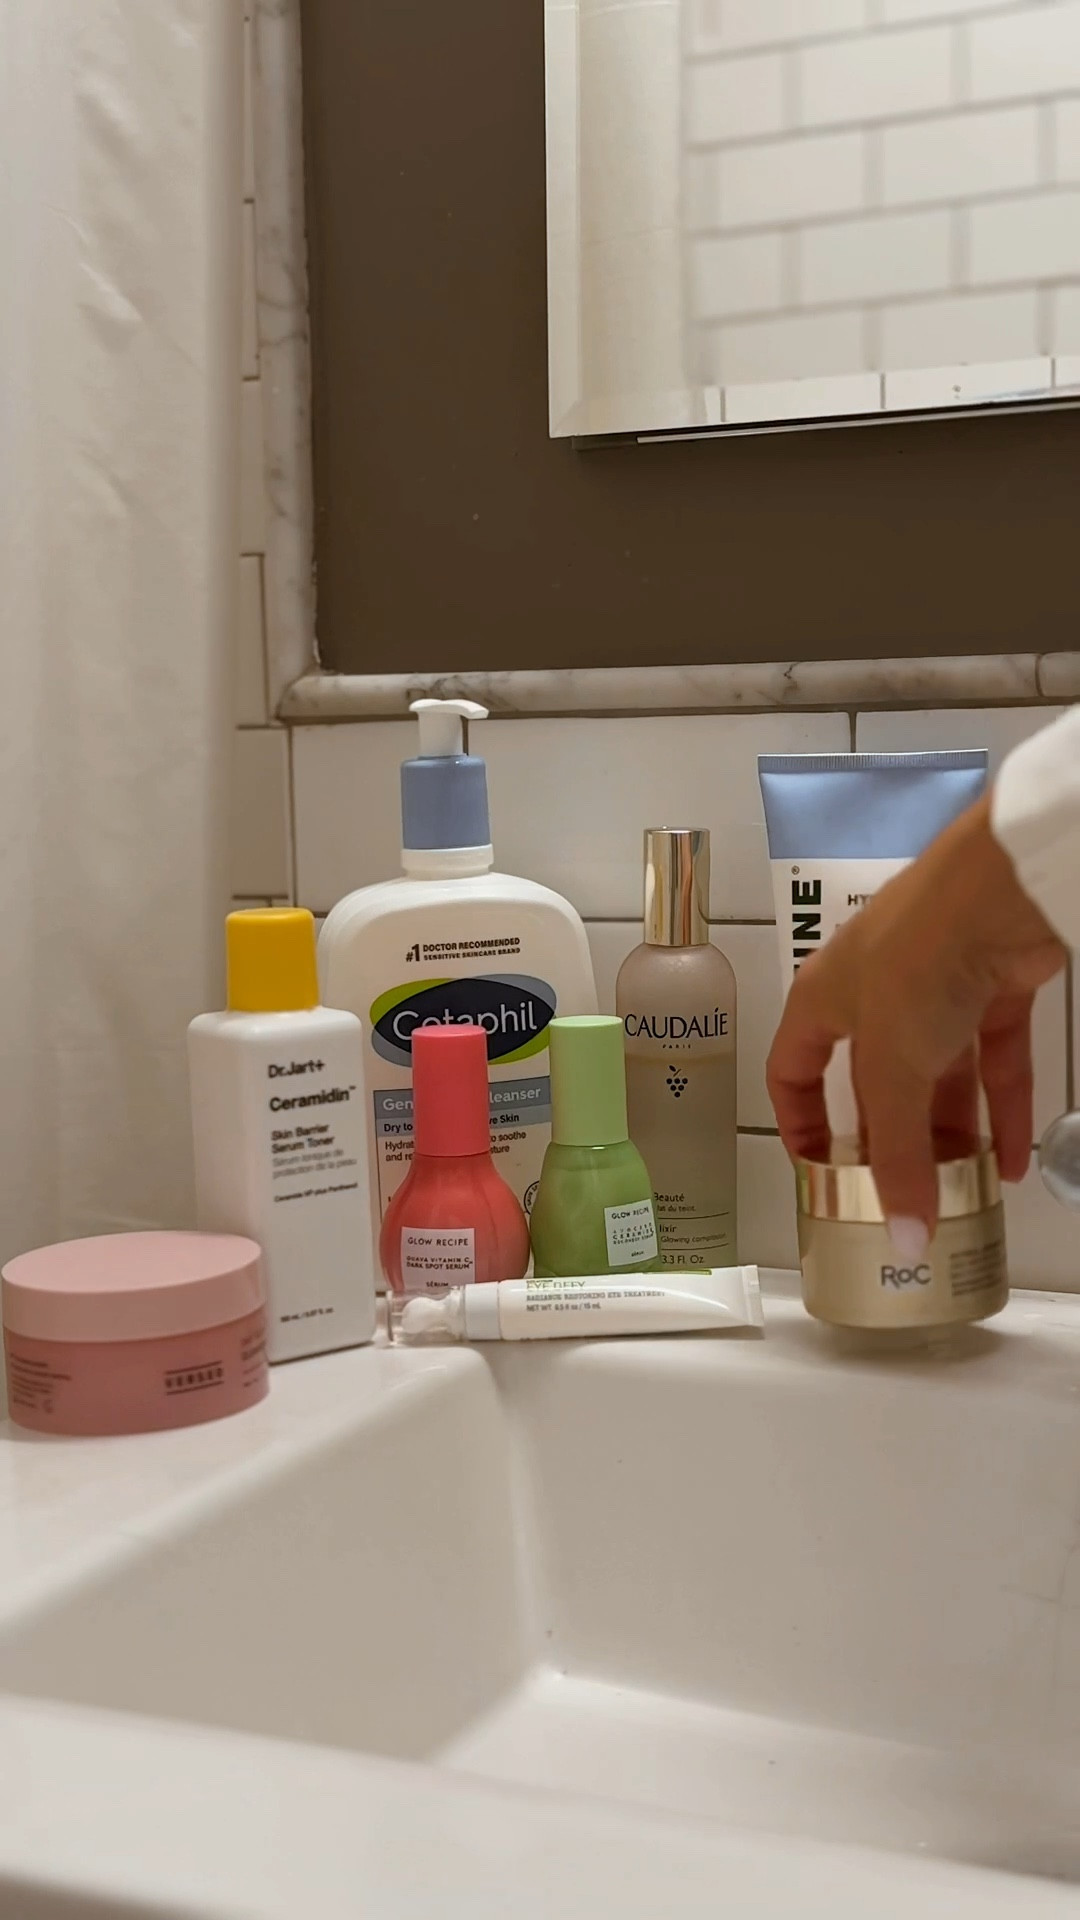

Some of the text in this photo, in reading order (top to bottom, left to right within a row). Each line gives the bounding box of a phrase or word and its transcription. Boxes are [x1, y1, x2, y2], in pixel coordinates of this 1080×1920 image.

[405, 937, 520, 962] #1 DOCTOR RECOMMENDED
[424, 947, 521, 961] SENSITIVE SKINCARE BRAND
[268, 1060, 325, 1079] Dr.Jart+
[383, 1088, 541, 1111] Gen leanser
[500, 1114, 520, 1123] Skin
[272, 1124, 329, 1141] Skin Barrier
[383, 1123, 413, 1134] Dry to
[272, 1136, 335, 1154] Serum Toner
[385, 1140, 414, 1152] Hydrat
[498, 1131, 527, 1142] soothe
[386, 1153, 403, 1161] and
[611, 1212, 631, 1220] GLOW
[659, 1224, 677, 1233] lixir
[407, 1237, 468, 1247] GLOW RECIPE
[661, 1235, 690, 1244] Glowing
[880, 1263, 932, 1288] RoC
[526, 1304, 540, 1312] NET
